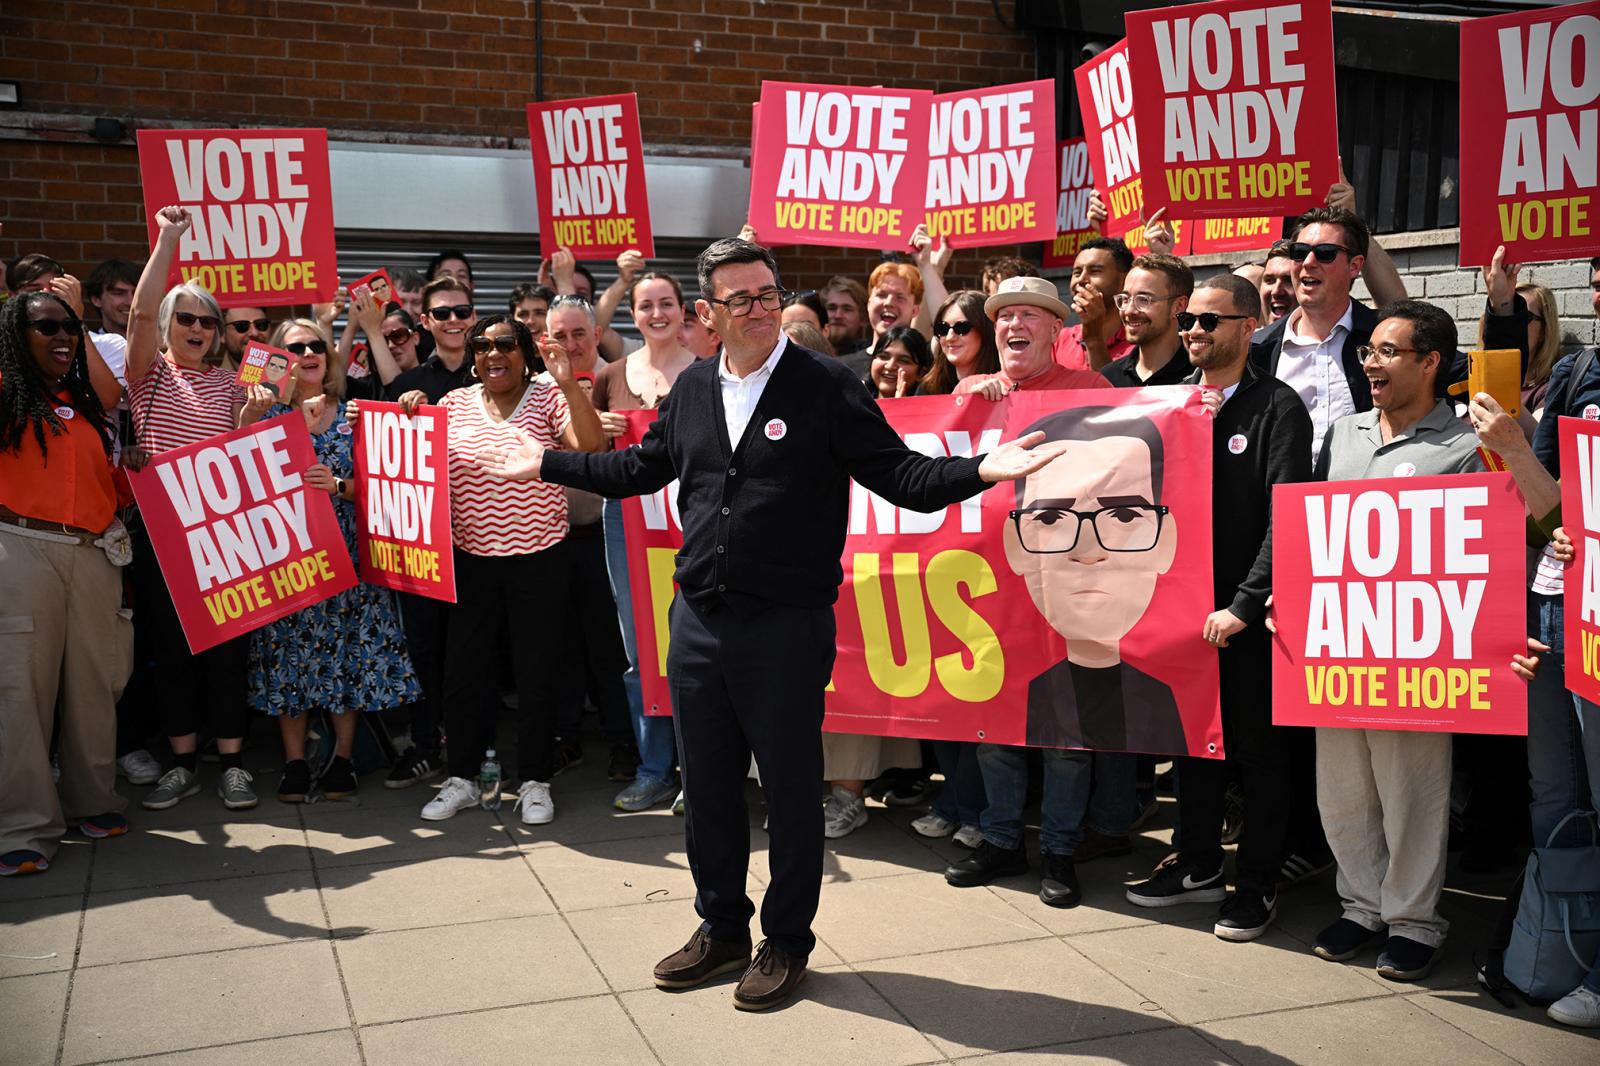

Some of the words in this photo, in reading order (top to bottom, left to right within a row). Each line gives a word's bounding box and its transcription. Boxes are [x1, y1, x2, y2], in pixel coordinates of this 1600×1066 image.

[1152, 4, 1306, 93] VOTE
[1498, 15, 1600, 113] VO
[1088, 48, 1134, 128] VO
[541, 104, 628, 165] VOTE
[785, 90, 911, 152] VOTE
[928, 90, 1035, 156] VOTE
[1164, 86, 1304, 163] ANDY
[166, 138, 309, 202] VOTE
[776, 147, 905, 204] ANDY
[925, 148, 1034, 208] ANDY
[1060, 140, 1094, 189] VO
[1101, 115, 1141, 188] AN
[1165, 166, 1232, 201] VOTE
[1238, 161, 1312, 199] HOPE
[1498, 109, 1598, 196] AN
[552, 163, 628, 216] ANDY
[775, 201, 834, 231] VOTE
[840, 205, 903, 236] HOPE
[925, 208, 976, 238] VOTE
[982, 201, 1036, 233] HOPE
[1056, 188, 1092, 233] AND
[1498, 196, 1590, 242] VOTE
[179, 202, 308, 261] ANDY
[553, 219, 593, 246] VOTE
[596, 218, 637, 245] HOPE
[1053, 234, 1076, 256] VOTE
[181, 264, 247, 293] VOTE
[252, 261, 317, 292] HOPE
[240, 373, 260, 385] HOPE
[243, 365, 263, 376] VOTE
[246, 356, 266, 367] ANDY
[249, 347, 270, 360] VOTE
[155, 425, 304, 528] VOTE
[363, 411, 435, 483] VOTE
[368, 477, 434, 545] ANDY
[1304, 486, 1489, 578] VOTE
[186, 491, 315, 592] ANDY
[368, 540, 401, 573] VOTE
[404, 546, 441, 583] HOPE
[204, 575, 272, 626] VOTE
[272, 550, 336, 601] HOPE
[853, 549, 1005, 703] US
[1304, 579, 1487, 660] ANDY
[1304, 665, 1388, 706] VOTE
[1397, 666, 1491, 711] HOPE
